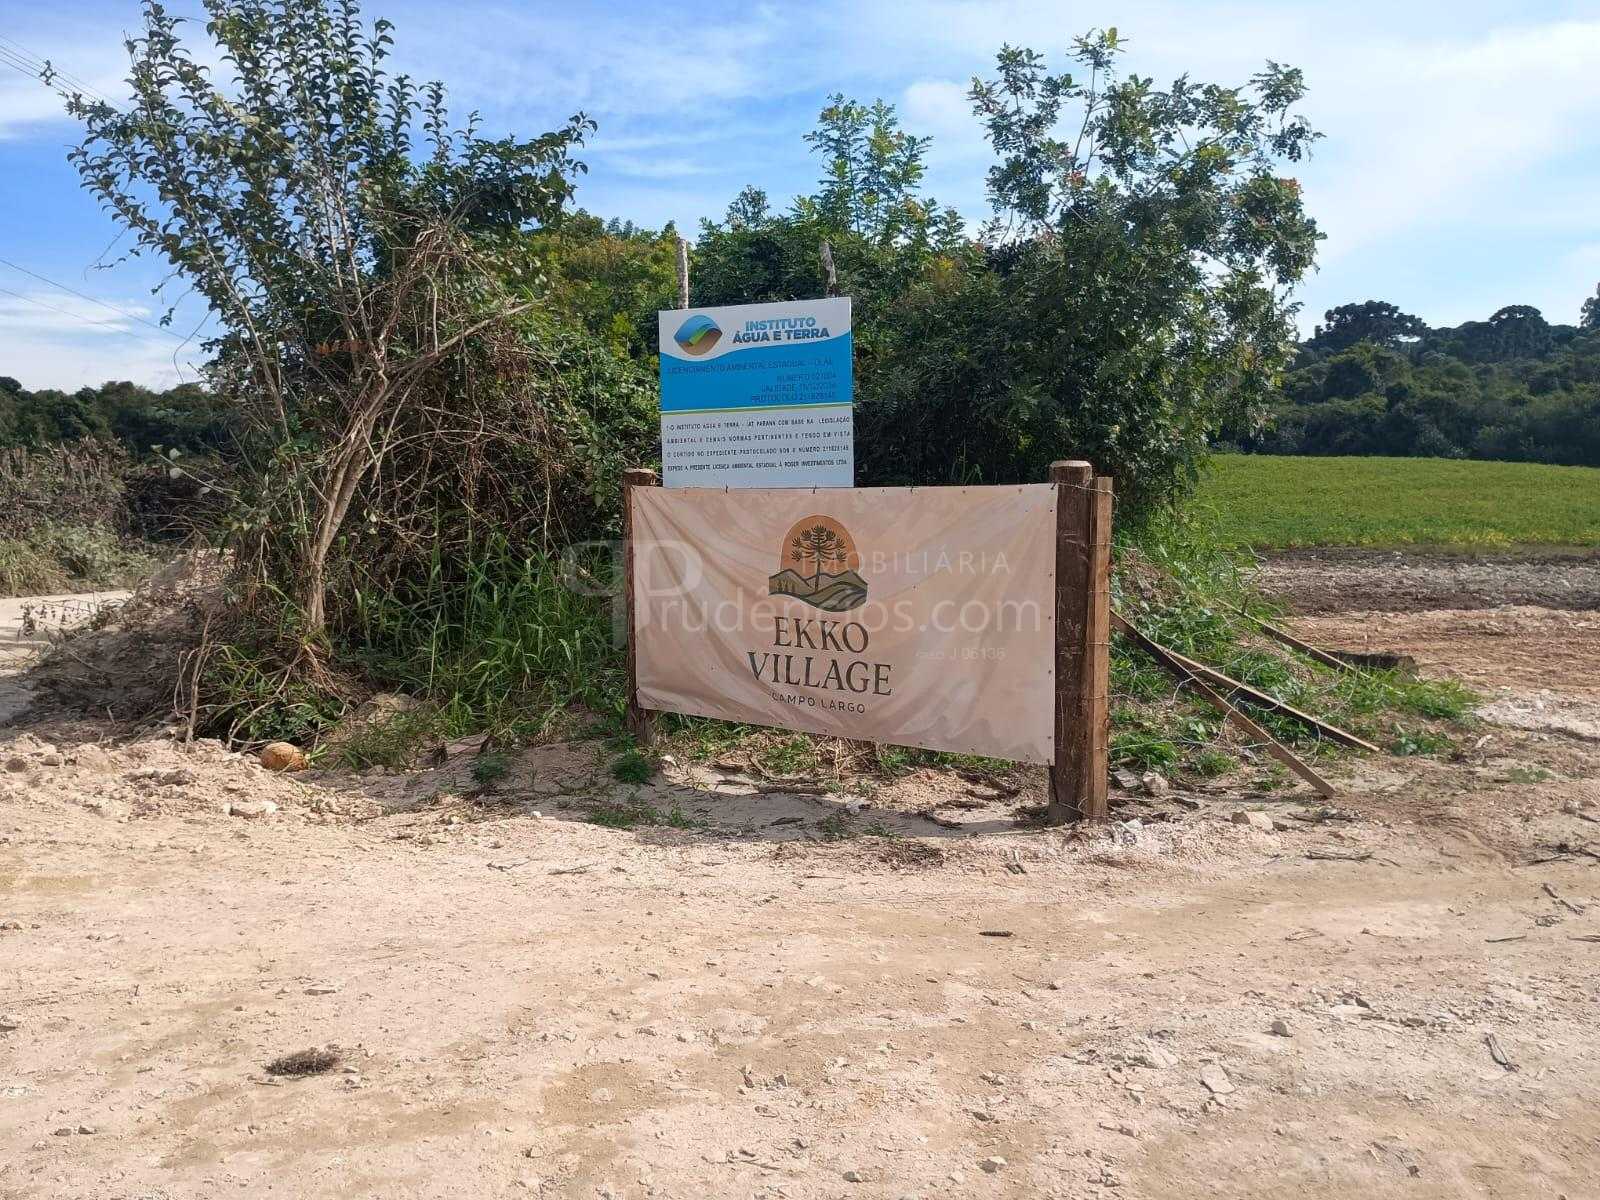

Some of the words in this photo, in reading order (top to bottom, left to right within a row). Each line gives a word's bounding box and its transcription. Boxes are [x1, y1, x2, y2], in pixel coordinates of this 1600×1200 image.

[745, 317, 816, 331] INSTITUTO
[733, 330, 770, 344] ÁGUA
[773, 331, 781, 341] E
[784, 328, 830, 340] TERRA
[773, 616, 869, 653] EKKO
[747, 651, 892, 696] VILLAGE
[771, 692, 816, 707] CAMPO
[821, 699, 866, 713] LARGO
